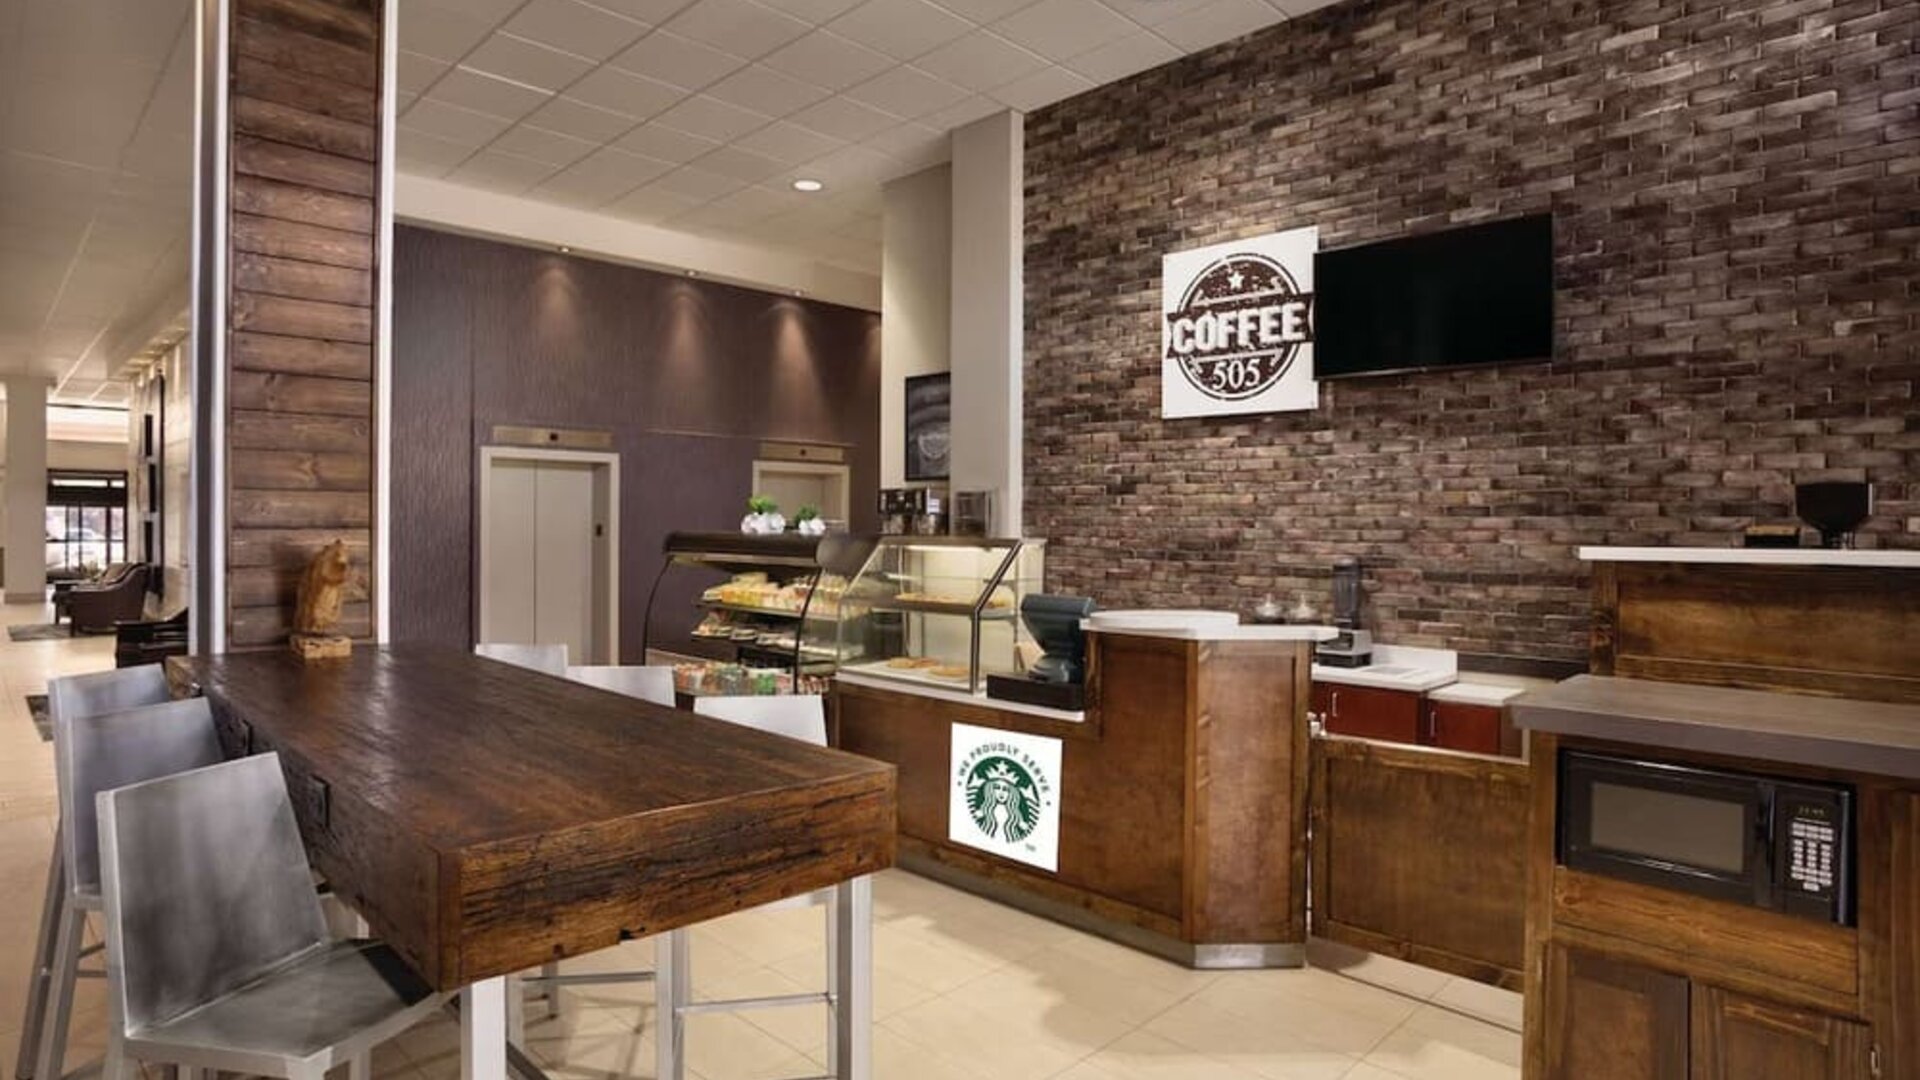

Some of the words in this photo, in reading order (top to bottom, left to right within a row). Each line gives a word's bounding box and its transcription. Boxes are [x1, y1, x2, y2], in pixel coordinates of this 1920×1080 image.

[1173, 302, 1306, 353] COFFEE
[1212, 358, 1261, 389] 505
[959, 760, 970, 777] WE
[969, 742, 1019, 759] PROUDLY
[1022, 754, 1050, 792] SERVE
